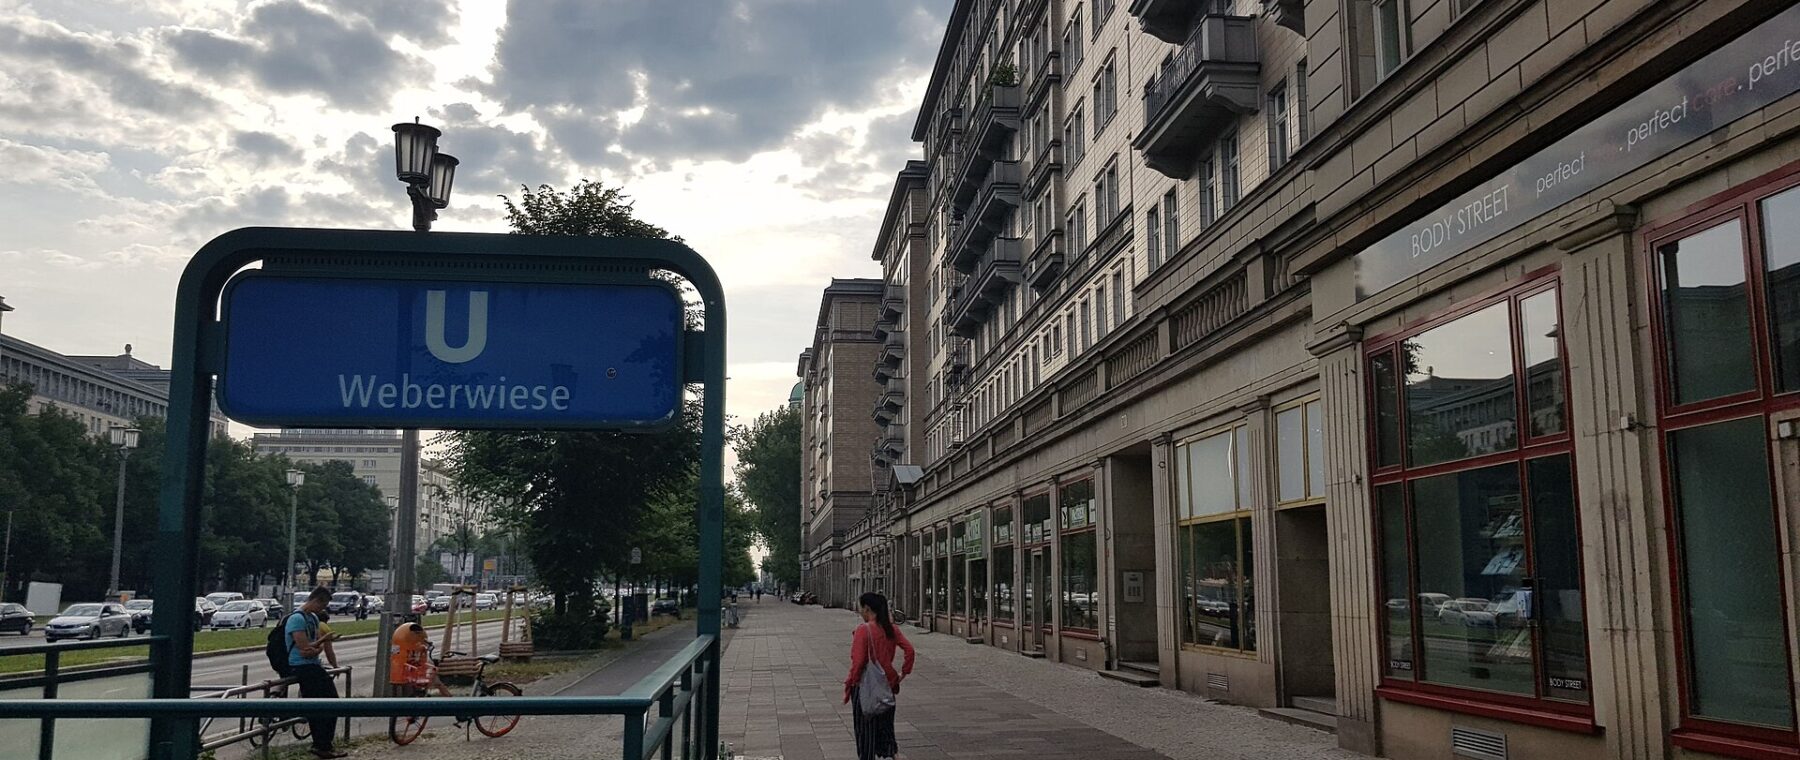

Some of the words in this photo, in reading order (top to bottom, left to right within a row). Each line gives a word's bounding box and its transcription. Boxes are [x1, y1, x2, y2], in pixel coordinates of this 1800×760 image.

[1536, 151, 1586, 199] perfect
[1627, 95, 1689, 152] perfect
[1411, 215, 1453, 258] BODY
[1457, 184, 1510, 235] STREET
[425, 290, 489, 364] U
[338, 373, 570, 411] Weberwiese
[1549, 678, 1564, 687] BODY
[1565, 679, 1581, 689] STREET
